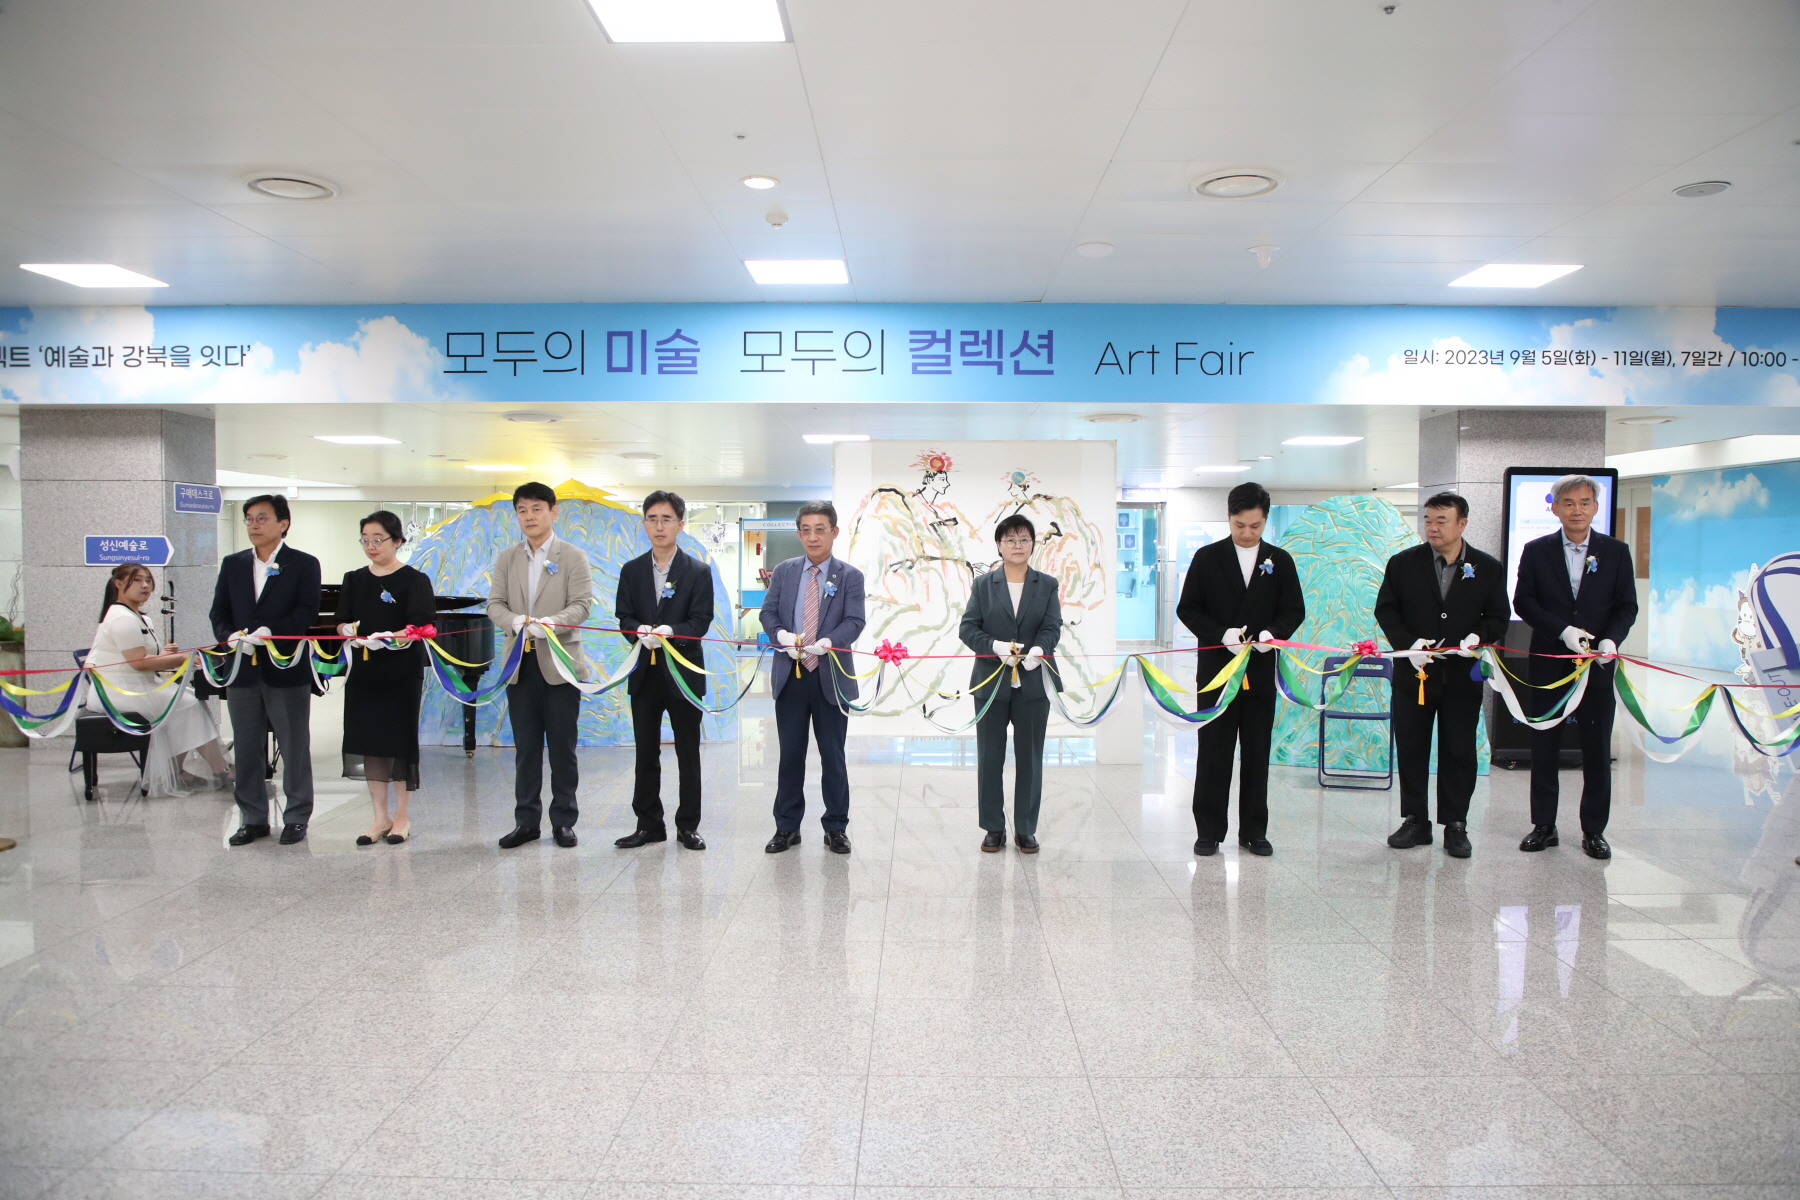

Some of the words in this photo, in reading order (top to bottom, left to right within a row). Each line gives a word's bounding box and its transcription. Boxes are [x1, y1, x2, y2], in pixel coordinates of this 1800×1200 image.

[122, 345, 192, 368] 강북을
[443, 329, 585, 377] 모두의
[606, 328, 701, 376] 미술
[740, 329, 885, 376] 모두의
[908, 328, 1055, 376] 컬렉션
[1095, 341, 1160, 376] Art
[1176, 341, 1255, 376] Fair
[1403, 348, 1439, 366] 일시:
[1445, 349, 1504, 366] 2023년
[1510, 349, 1536, 366] 9월
[1541, 349, 1597, 367] 5일(화)
[1613, 350, 1676, 368] 11일(월),
[1681, 350, 1723, 367] 7일간
[1741, 351, 1787, 367] 10:00
[180, 487, 214, 500] 구매데스크로
[100, 540, 149, 552] 성신예술로
[99, 553, 150, 562] Sungsinyesul-ro
[1767, 673, 1800, 720] E-OUT
